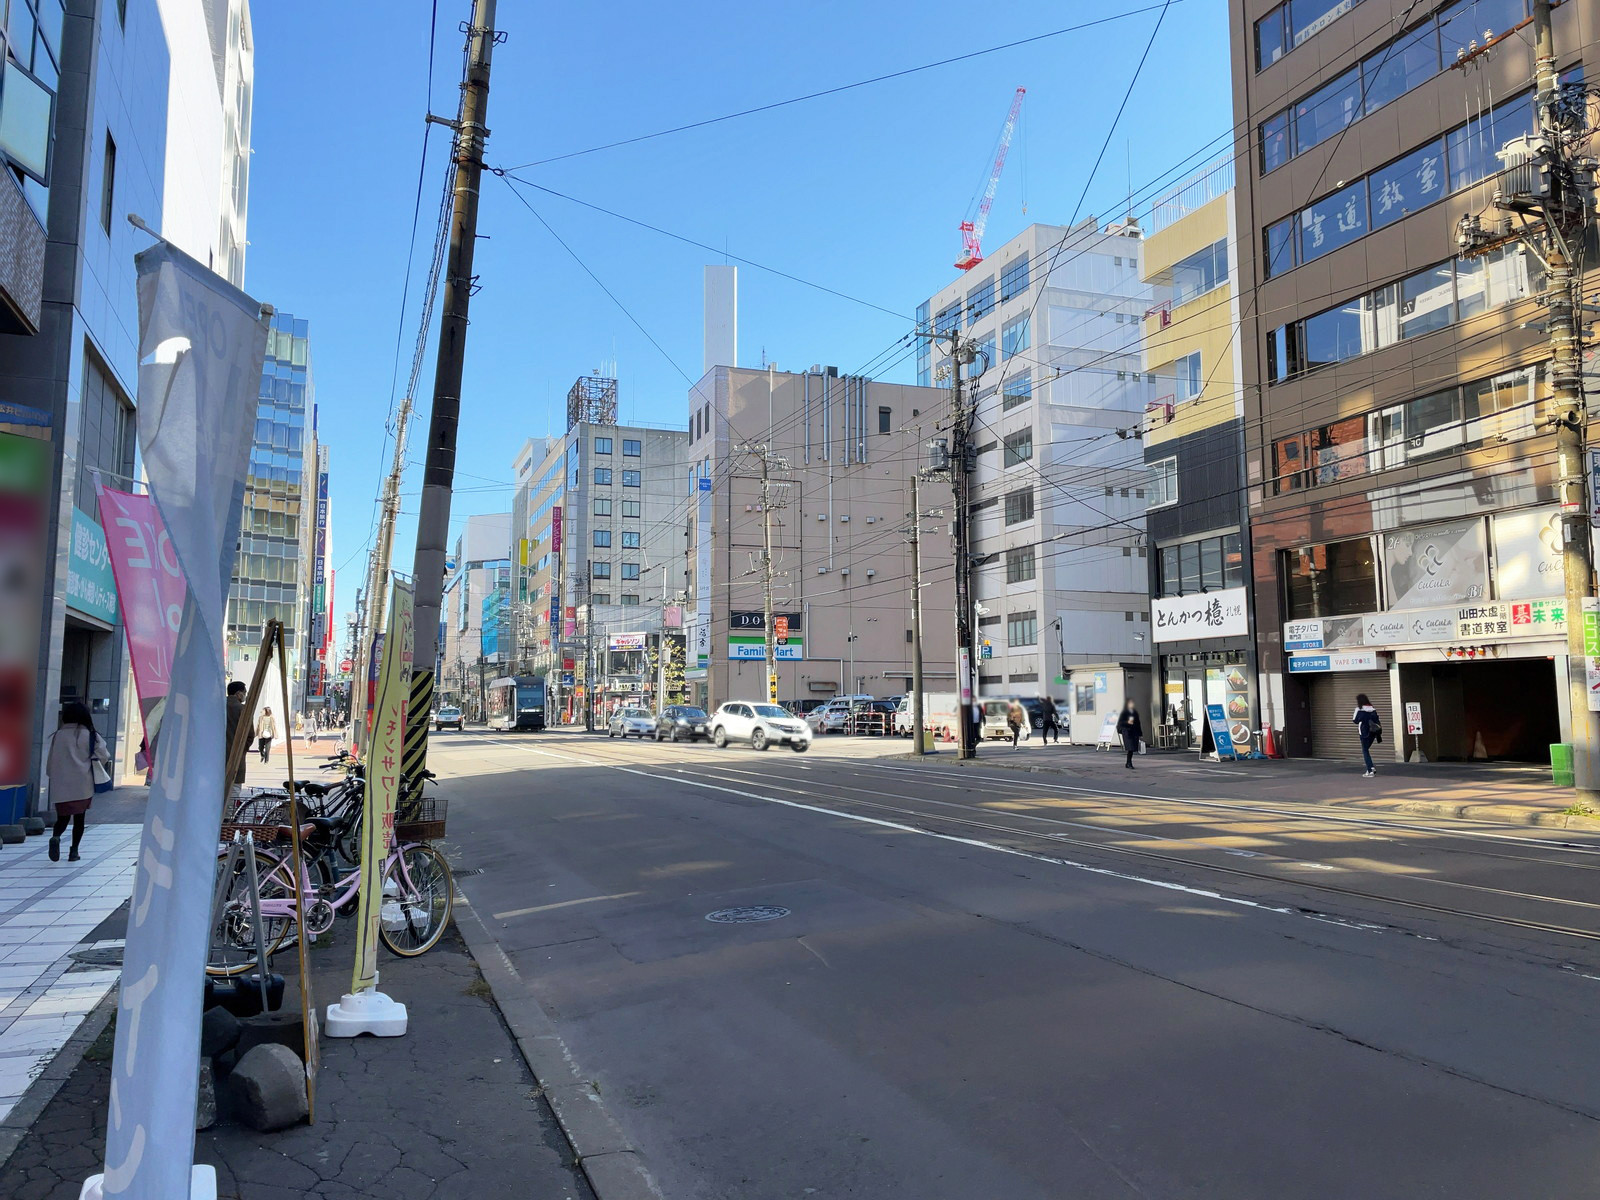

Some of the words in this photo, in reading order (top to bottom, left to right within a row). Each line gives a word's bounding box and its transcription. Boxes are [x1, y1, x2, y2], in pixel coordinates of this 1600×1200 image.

[1467, 584, 1484, 599] B1
[1532, 607, 1565, 624] 未来
[1288, 624, 1319, 634] 電子タバコ
[1460, 620, 1509, 636] 書道教室
[1584, 613, 1600, 654] ロゴス
[1302, 641, 1320, 649] STORE
[1293, 660, 1327, 668] 電子タバコ専門店
[1351, 657, 1371, 665] STORE
[1408, 724, 1416, 734] P
